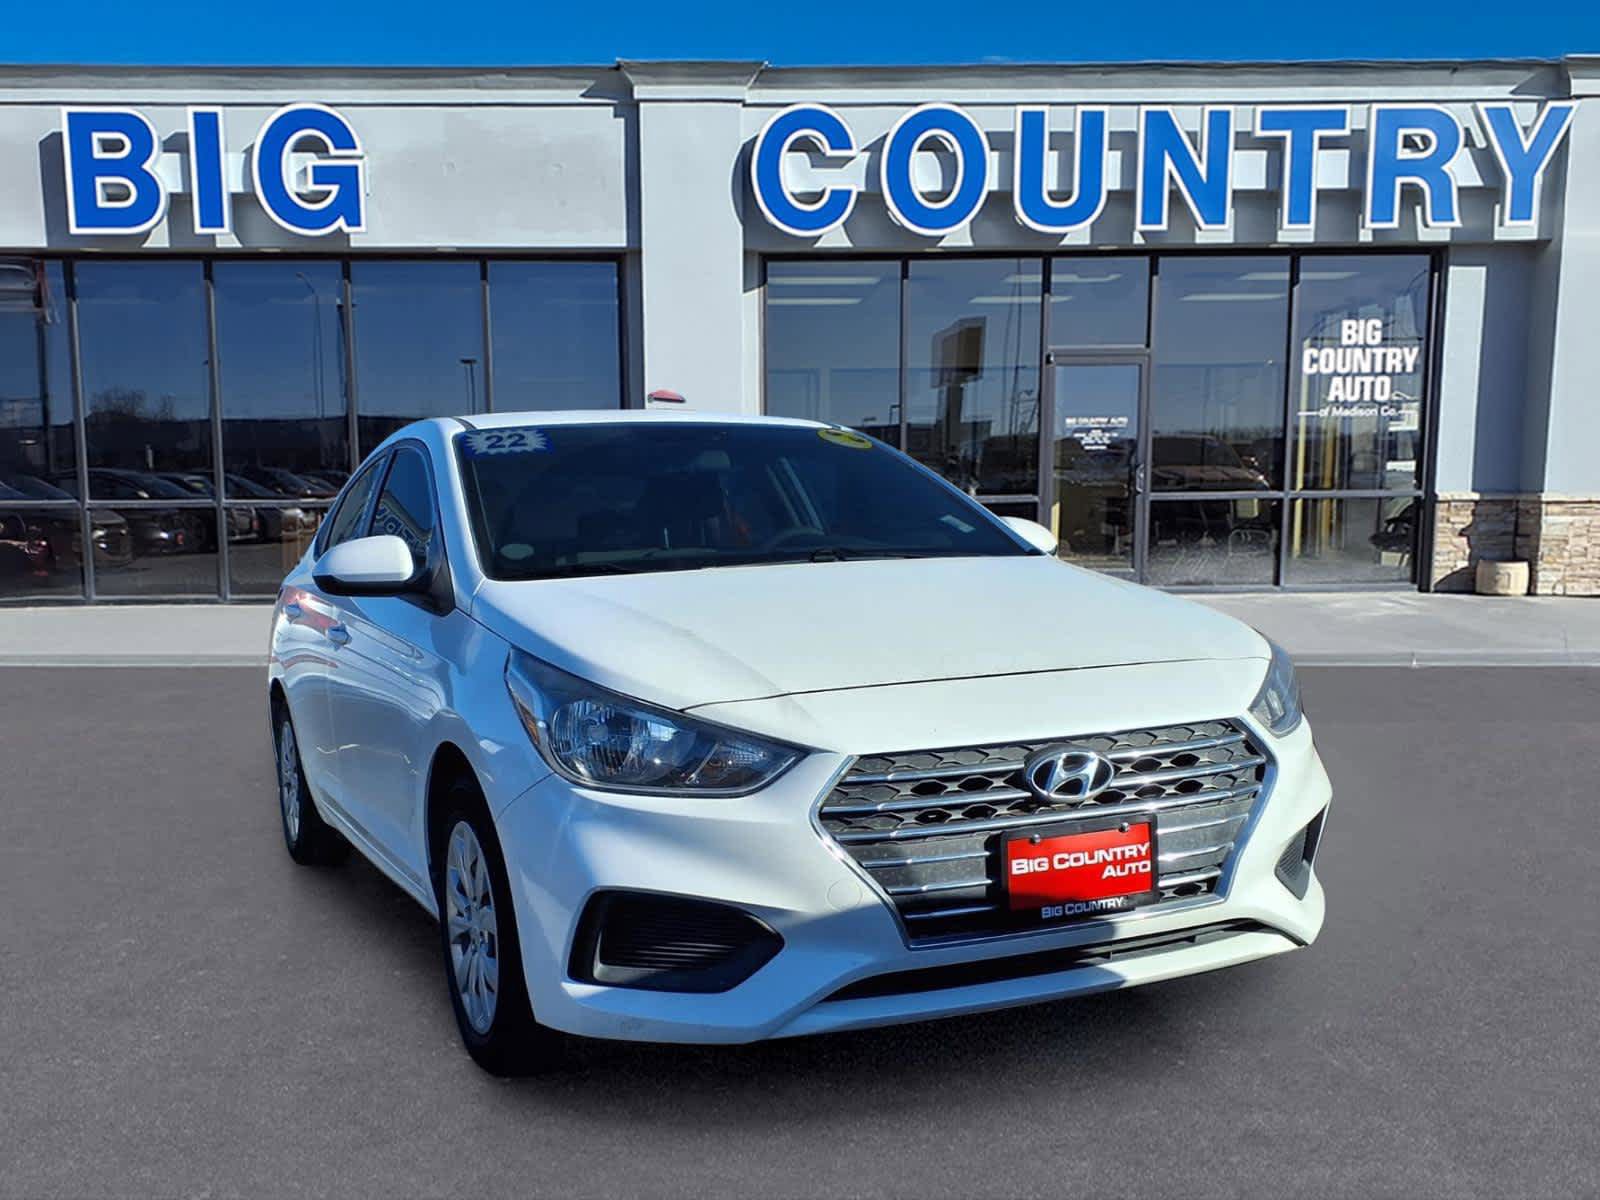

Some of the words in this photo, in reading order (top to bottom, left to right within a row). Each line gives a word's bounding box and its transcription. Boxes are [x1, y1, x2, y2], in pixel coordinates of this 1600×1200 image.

[61, 103, 366, 236] BIG
[751, 102, 1577, 237] COUNTRY
[1341, 319, 1382, 346] BIG
[1302, 346, 1419, 375] COUNTRY
[1328, 375, 1391, 402] AUTO
[484, 432, 529, 450] 22
[1011, 857, 1049, 875] BIG
[1052, 841, 1151, 870] COUNTRY
[1101, 859, 1152, 880] AUTO
[1041, 904, 1063, 919] BIG
[1064, 896, 1124, 916] COUNTRY
